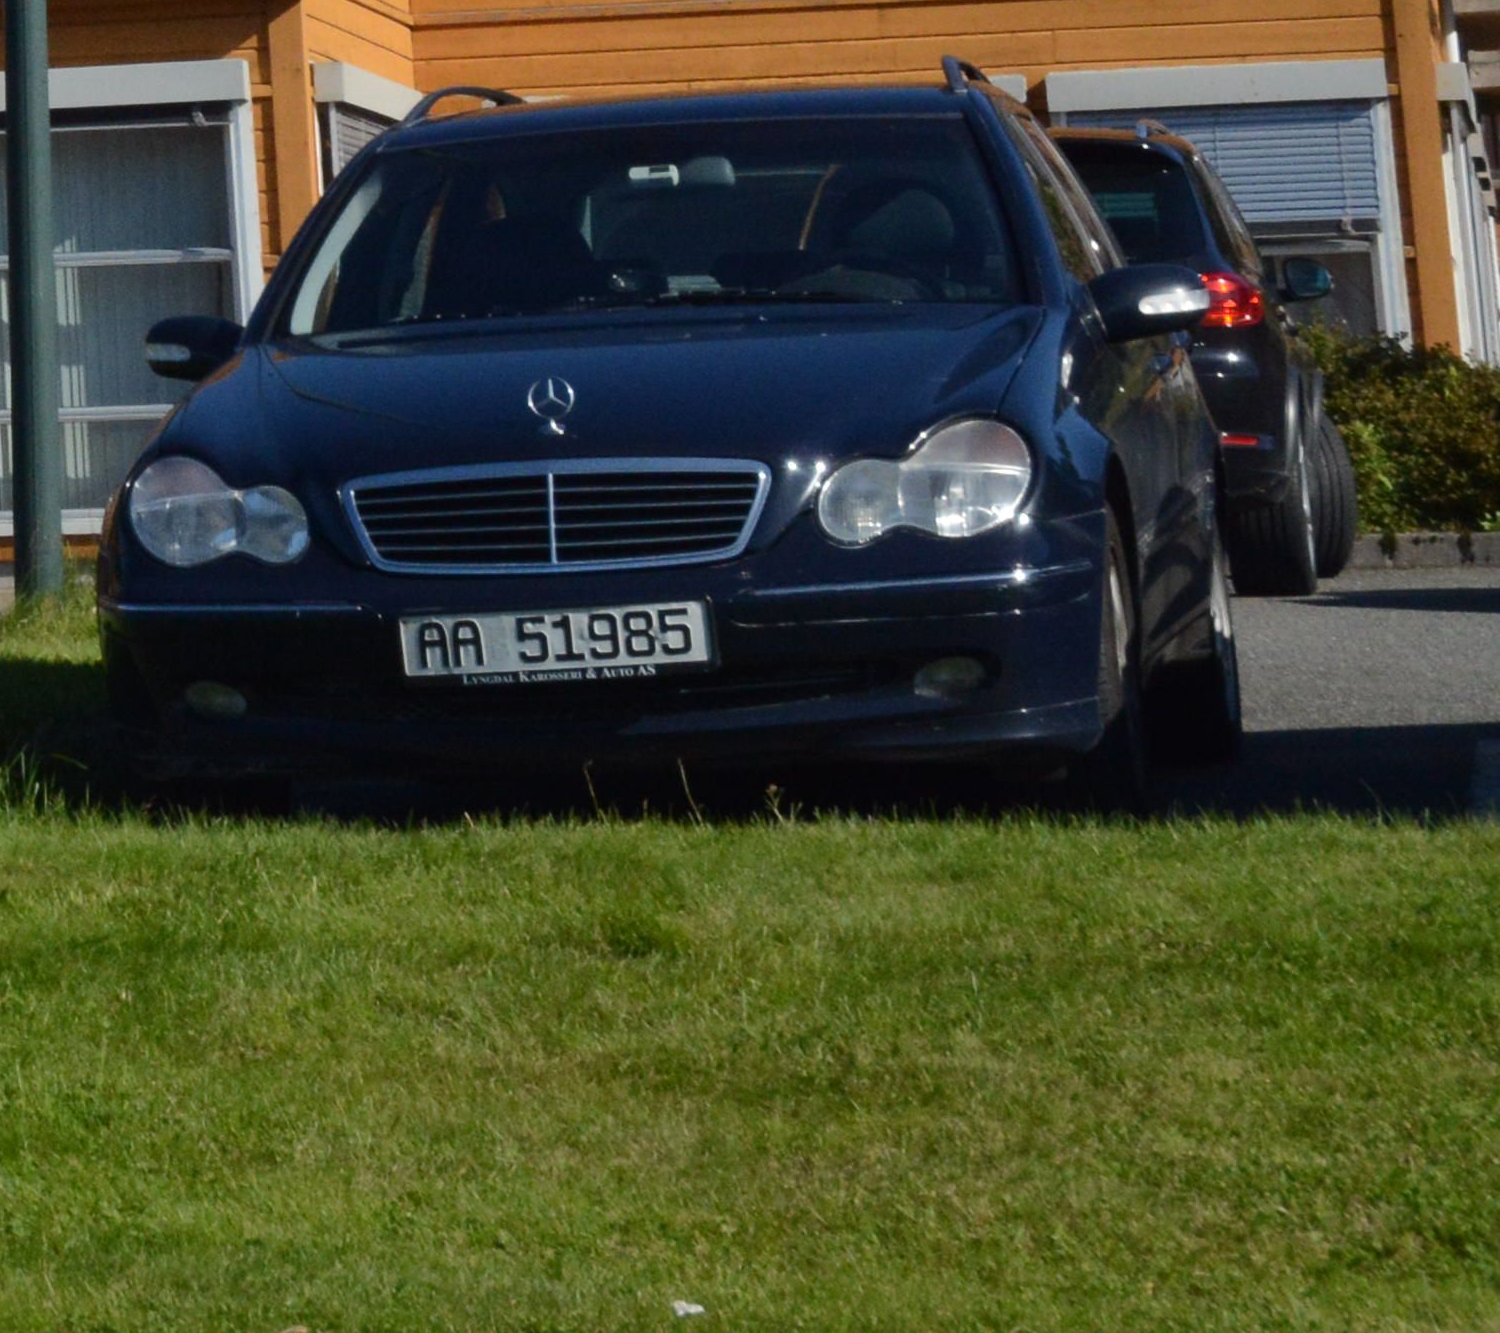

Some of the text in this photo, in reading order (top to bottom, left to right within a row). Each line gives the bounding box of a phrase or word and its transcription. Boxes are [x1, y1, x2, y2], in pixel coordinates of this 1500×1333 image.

[418, 607, 693, 668] AA 51985
[585, 668, 597, 680] &
[601, 667, 634, 679] AUTO
[637, 664, 657, 677] AS
